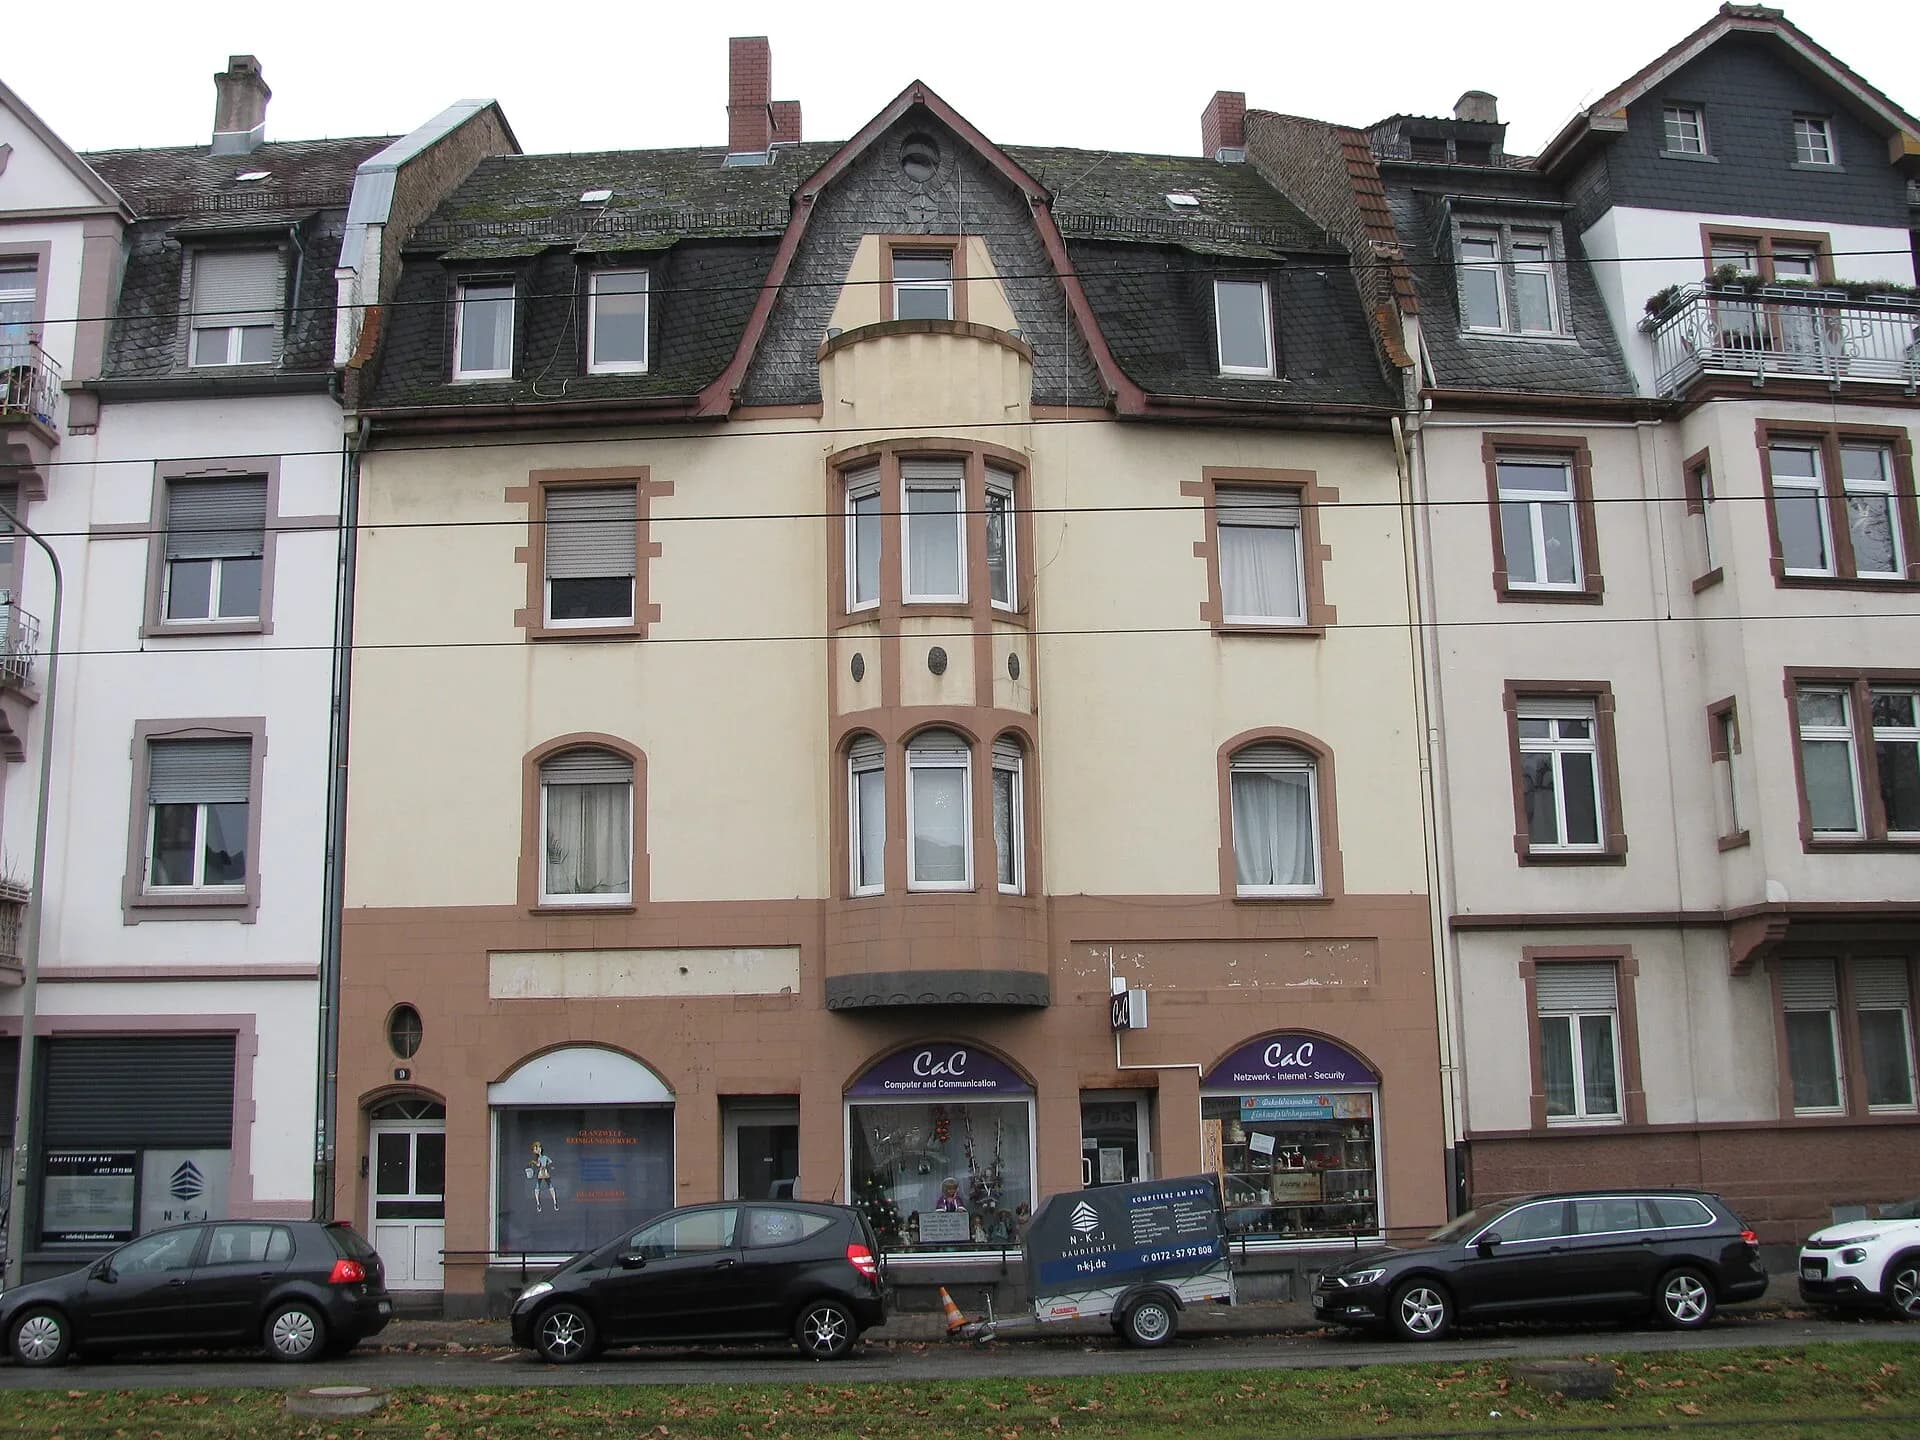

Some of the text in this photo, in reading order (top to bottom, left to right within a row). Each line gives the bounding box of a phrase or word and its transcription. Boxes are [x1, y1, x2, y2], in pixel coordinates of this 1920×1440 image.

[1112, 996, 1128, 1027] CaC
[912, 1050, 967, 1076] CaC
[1263, 1042, 1314, 1068] CaC
[1233, 1072, 1271, 1081] Netzwerk
[1277, 1071, 1307, 1080] Internet
[1314, 1071, 1345, 1081] Security
[884, 1079, 997, 1090] Computer and Communication
[1132, 1192, 1173, 1203] KOMPETENZ
[1190, 1188, 1204, 1196] BAU
[1062, 1243, 1117, 1258] BAUDIENSTE
[1151, 1251, 1171, 1262] 0172
[1175, 1248, 1186, 1258] 57
[1186, 1247, 1197, 1257] 92
[1198, 1245, 1213, 1255] 808
